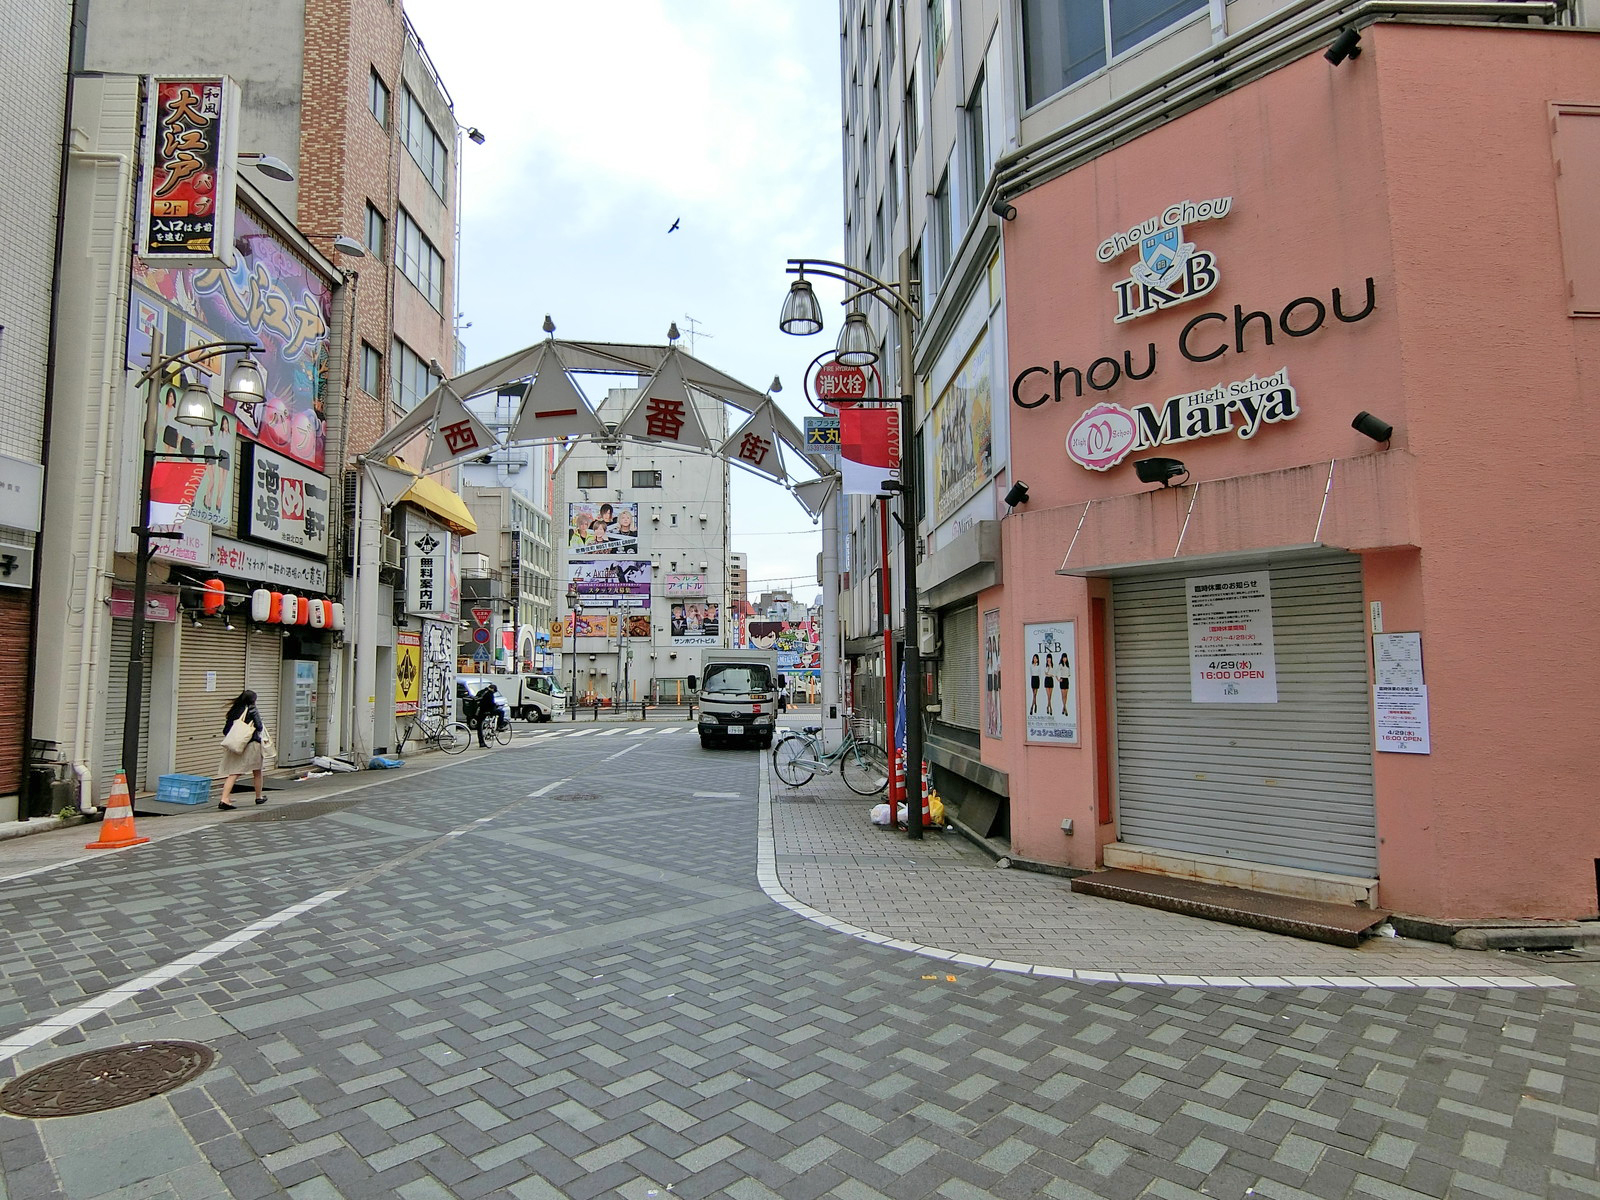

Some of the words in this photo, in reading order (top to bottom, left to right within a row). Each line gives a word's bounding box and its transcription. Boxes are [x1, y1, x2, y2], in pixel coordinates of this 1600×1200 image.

[203, 88, 220, 115] 和風
[155, 87, 210, 198] 大江戸
[163, 201, 182, 216] 2F
[1115, 253, 1216, 320] IKB
[1012, 342, 1157, 409] Chou
[1178, 276, 1376, 363] Chou
[819, 374, 863, 395] 消火栓
[823, 365, 835, 373] FIRE
[834, 365, 858, 373] HYDRANT
[1187, 389, 1226, 407] High
[1229, 372, 1285, 398] School
[886, 409, 900, 456] TOKYO
[1133, 387, 1297, 448] Marya
[808, 428, 842, 444] 大丸
[256, 458, 280, 531] 酒場
[281, 477, 305, 521] め
[304, 482, 328, 542] 一軒
[419, 557, 434, 611] 無料案内所
[668, 582, 703, 591] アイドル
[1194, 580, 1258, 593] 臨時休業のお知らせ
[1038, 642, 1062, 654] IKB
[1200, 671, 1231, 680] 16:00
[1233, 670, 1265, 679] OPEN
[1208, 660, 1252, 670] 4/29(水)
